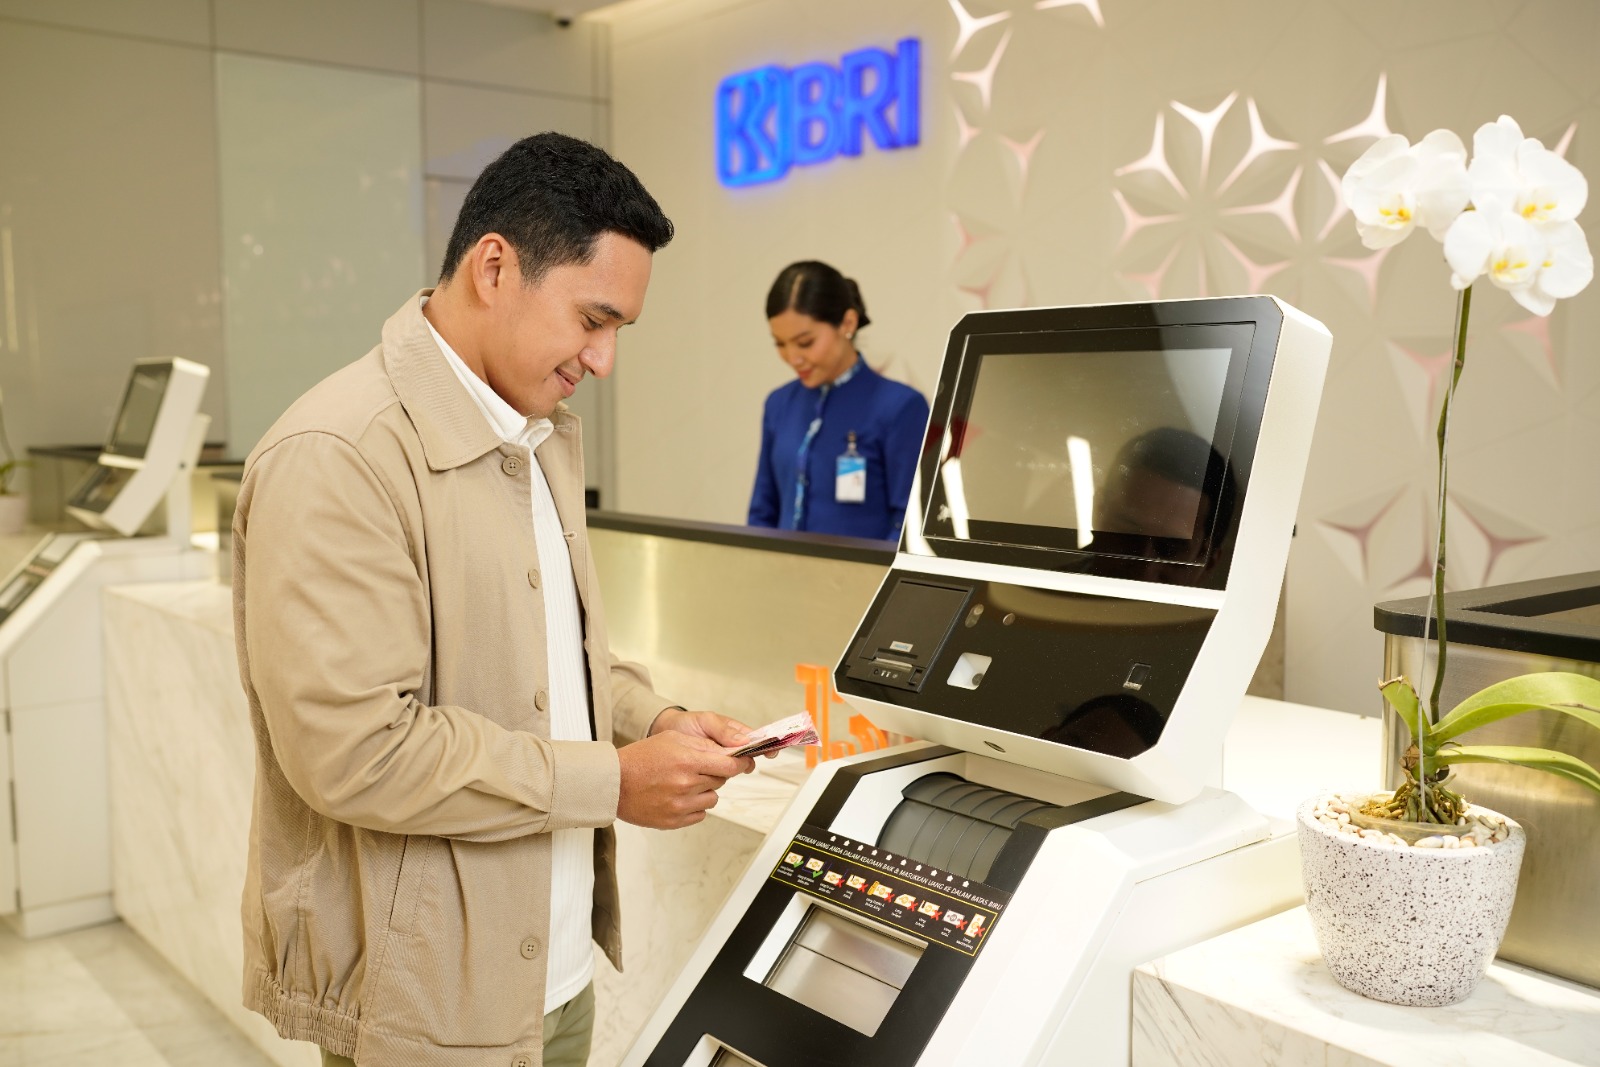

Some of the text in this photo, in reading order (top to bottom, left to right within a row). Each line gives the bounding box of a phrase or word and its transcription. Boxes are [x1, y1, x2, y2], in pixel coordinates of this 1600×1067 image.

[791, 37, 921, 166] BRI
[795, 834, 817, 845] PASTIKAN
[816, 840, 831, 850] UANG
[829, 846, 843, 854] ANDA
[842, 849, 862, 860] DALAM
[860, 856, 884, 868] KEADAAN
[881, 863, 895, 872] BAIK
[899, 870, 928, 884] MASUKKAN
[928, 879, 945, 890] UANG
[950, 888, 972, 900] DALAM
[970, 895, 989, 906] BATAS
[987, 900, 1004, 911] BIRU
